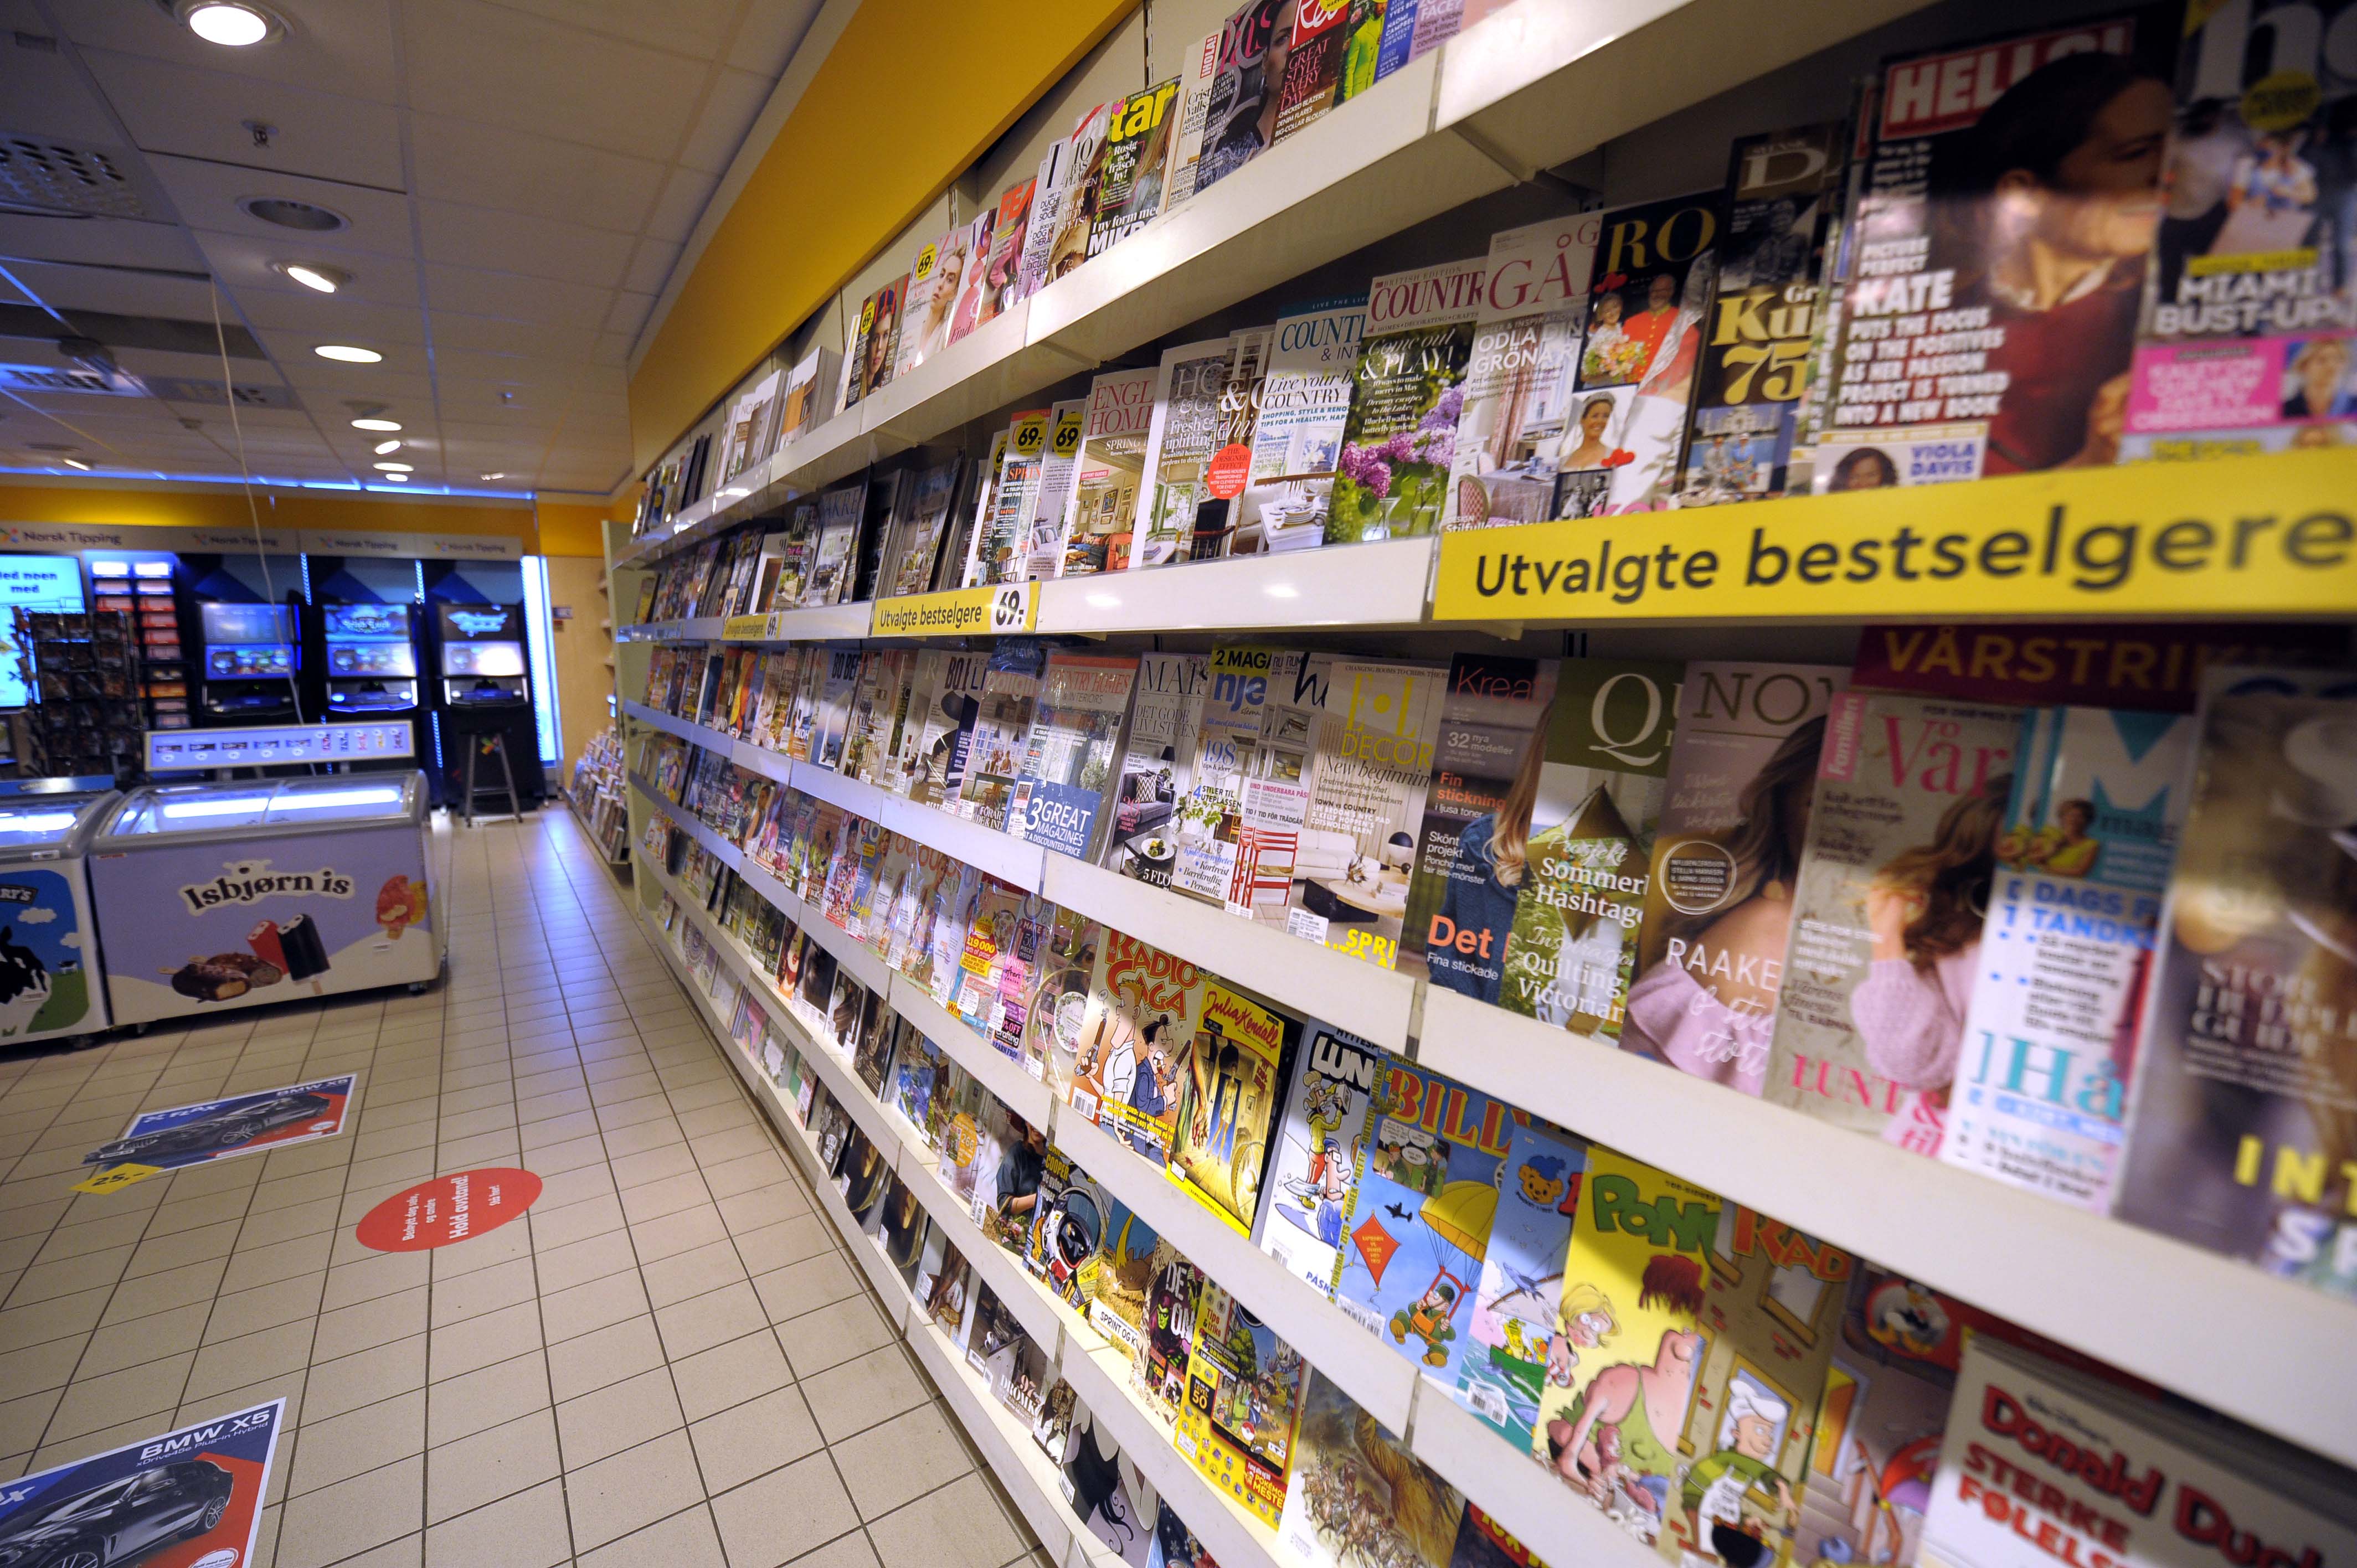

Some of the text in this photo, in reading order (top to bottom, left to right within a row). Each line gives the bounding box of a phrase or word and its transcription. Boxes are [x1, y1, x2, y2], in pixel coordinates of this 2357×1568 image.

[1289, 37, 1330, 70] GREAT
[1286, 56, 1321, 84] STYLE
[1283, 67, 1322, 97] EVERY
[1278, 92, 1326, 118] CHECKED BLAZERS
[1280, 89, 1304, 111] DAY
[1111, 84, 1181, 143] tar
[1277, 106, 1313, 128] DENIM FLARES
[1114, 140, 1139, 156] Rosig
[1116, 151, 1130, 163] och
[1108, 154, 1136, 176] fräsch
[1113, 168, 1128, 184] hy!
[1110, 213, 1137, 231] form
[1852, 269, 1954, 317] KATE
[2176, 269, 2317, 304] MIAMI
[1848, 306, 1992, 340] PUTS THE FOCUS
[1368, 328, 1455, 357] Come out
[1478, 327, 1537, 353] ODLA
[1912, 327, 2005, 355] POSITIVES
[1383, 345, 1454, 377] PLAY!
[1721, 339, 1810, 405] 75
[1906, 350, 1986, 377] PASSION
[1267, 374, 1340, 394] Live your
[1404, 375, 1424, 383] make
[1265, 388, 1343, 410] COUNTRY
[1375, 387, 1394, 396] merry
[1839, 379, 1910, 404] PROJECT
[1261, 420, 1274, 428] TIPS
[1296, 415, 1328, 424] HEALTHY,
[1262, 409, 1297, 420] SHOPPING,
[1834, 399, 1940, 426] INTO NEW
[1105, 437, 1141, 451] SPRING
[1911, 443, 1975, 461] VIOLA
[1908, 458, 1974, 477] DAVIS
[23, 531, 122, 546] Norsk Tipping
[336, 539, 398, 551] Norsk Tipping
[1475, 505, 2357, 606] Utvalgte bestselgere
[11, 584, 40, 594] med
[879, 600, 982, 632] Utvalgte bestselgere
[1214, 649, 1226, 666] 2
[1136, 704, 1157, 719] DET
[1340, 732, 1434, 768] DECOR
[1447, 731, 1470, 748] 32
[1470, 743, 1514, 755] modeller
[1203, 739, 1237, 767] 198
[1321, 755, 1355, 776] New
[1440, 771, 1463, 787] Fin
[1193, 785, 1223, 800] 4 STILER
[1201, 793, 1242, 808] UTEPLASSEN
[1262, 785, 1295, 797] UNDERBARA
[1370, 793, 1403, 806] lockdown
[1437, 788, 1507, 812] stickning
[1025, 797, 1092, 833] 3 GREAT
[1314, 798, 1334, 808] TOWN
[1343, 803, 1377, 815] COUNTRY
[1032, 834, 1081, 857] DISCOUNTED PRICE
[1036, 822, 1085, 847] MAGAZINES
[1429, 831, 1460, 847] Skönt
[1427, 843, 1465, 859] projekt
[1199, 860, 1229, 876] Kortreist
[1424, 855, 1475, 873] Poncho med
[1183, 867, 1223, 886] Bærekraftig
[1437, 869, 1486, 885] isle-mönster
[184, 870, 350, 911] Isbjørn is
[1190, 880, 1221, 898] Personlig
[1428, 914, 1494, 960] Det
[1105, 927, 1200, 990] RADIO
[1427, 952, 1499, 981] Fina stickade
[1524, 951, 1624, 998] Quilting
[1105, 959, 1187, 1022] GAGA
[1203, 991, 1280, 1049] Julia Kendall
[276, 1077, 349, 1097] BMW X5
[1124, 1112, 1137, 1124] MANN
[1155, 1117, 1168, 1131] BEDRE
[1044, 1154, 1069, 1182] COOPER
[1355, 1152, 1367, 1180] BETTY
[409, 1205, 419, 1218] deg
[449, 1174, 470, 1240] Hold avstand!
[425, 1215, 438, 1224] og
[1340, 1225, 1351, 1245] ZITS
[1165, 1261, 1188, 1301] DE
[1331, 1253, 1345, 1288] TUNDRA
[1099, 1311, 1131, 1341] SPRINT OG
[1206, 1307, 1221, 1325] Tips
[1207, 1322, 1222, 1338] triks
[1192, 1391, 1208, 1409] 50
[1193, 1384, 1209, 1399] LEVEL
[136, 1421, 269, 1467] xDrive45e Plug-in Hybrid
[139, 1409, 271, 1460] BMW X5
[1981, 1383, 2165, 1518] Donald
[1963, 1441, 2130, 1556] STERKE
